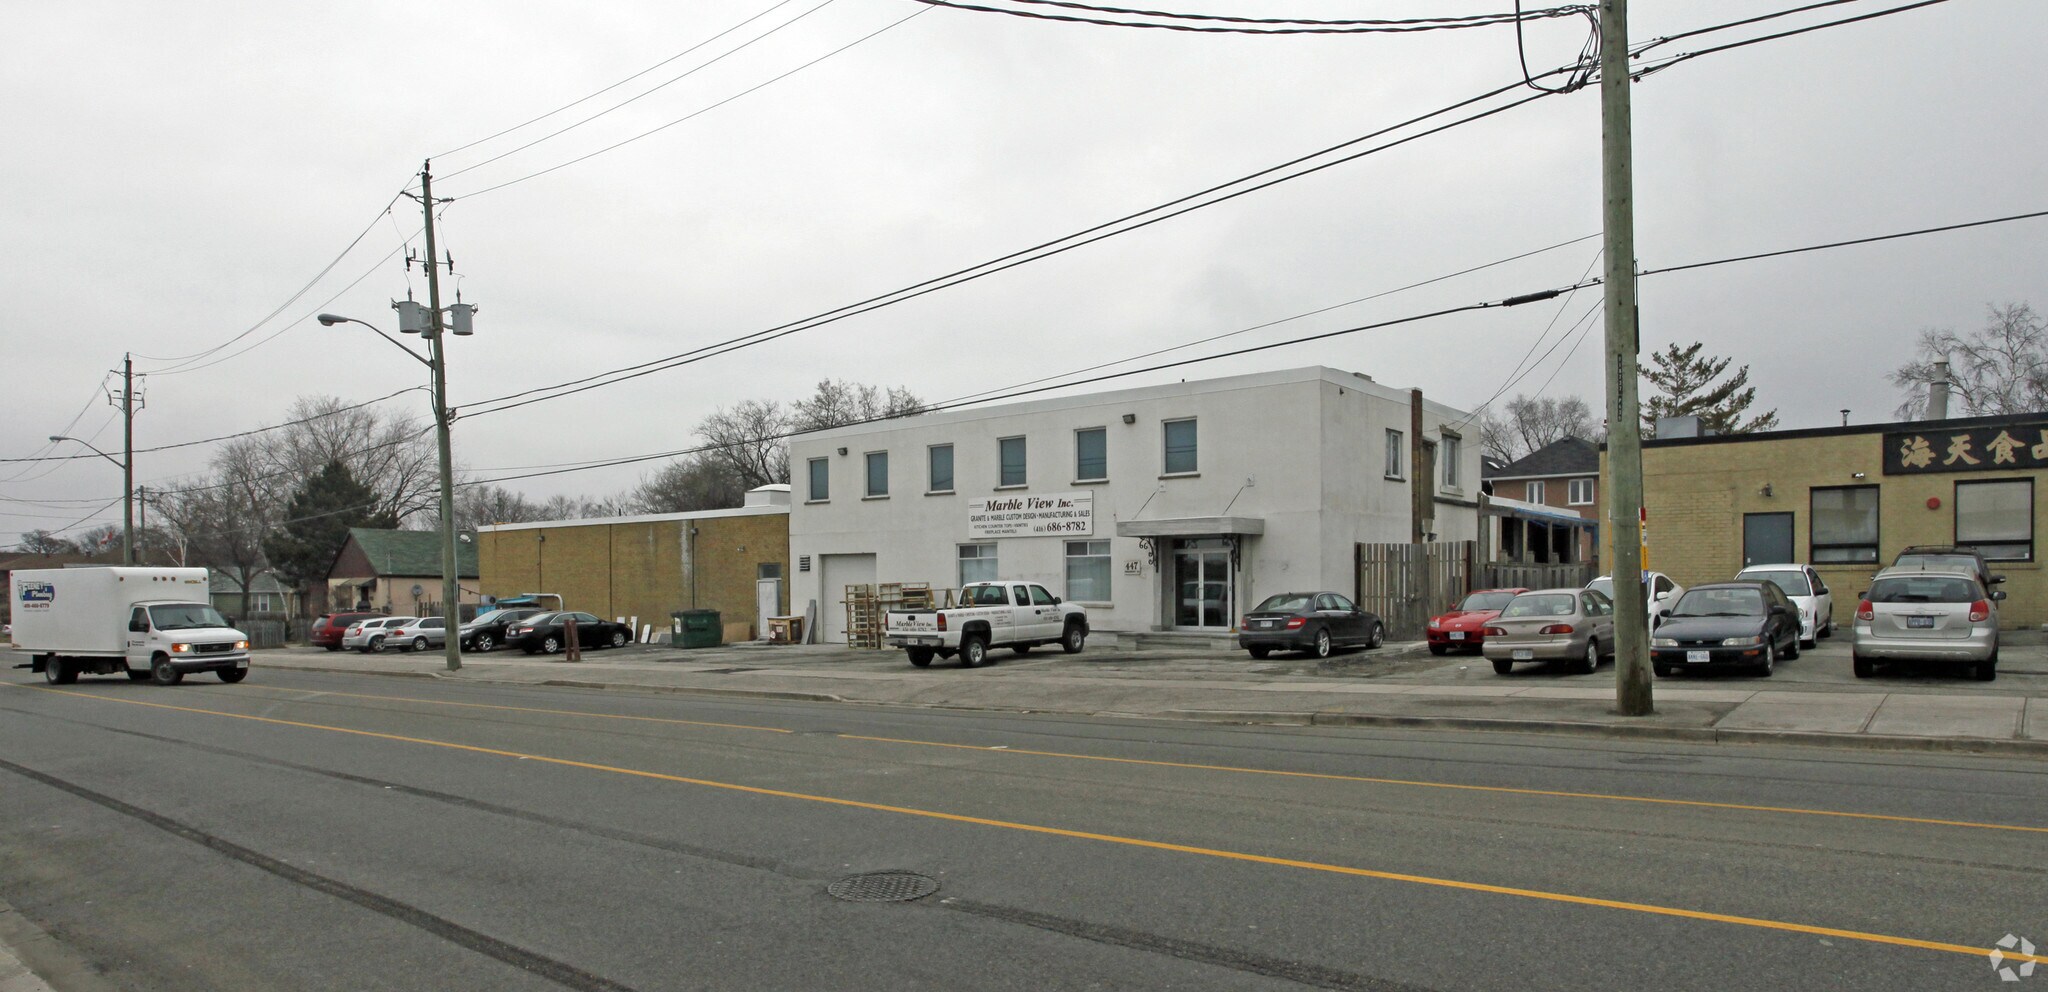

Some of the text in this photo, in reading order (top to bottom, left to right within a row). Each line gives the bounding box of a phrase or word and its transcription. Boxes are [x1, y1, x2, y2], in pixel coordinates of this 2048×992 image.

[985, 497, 1074, 512] Marble View Inc.
[970, 514, 987, 522] GRANITE
[1005, 513, 1022, 521] CUSTOM
[1046, 521, 1086, 532] 686-8782
[1125, 562, 1138, 570] 447
